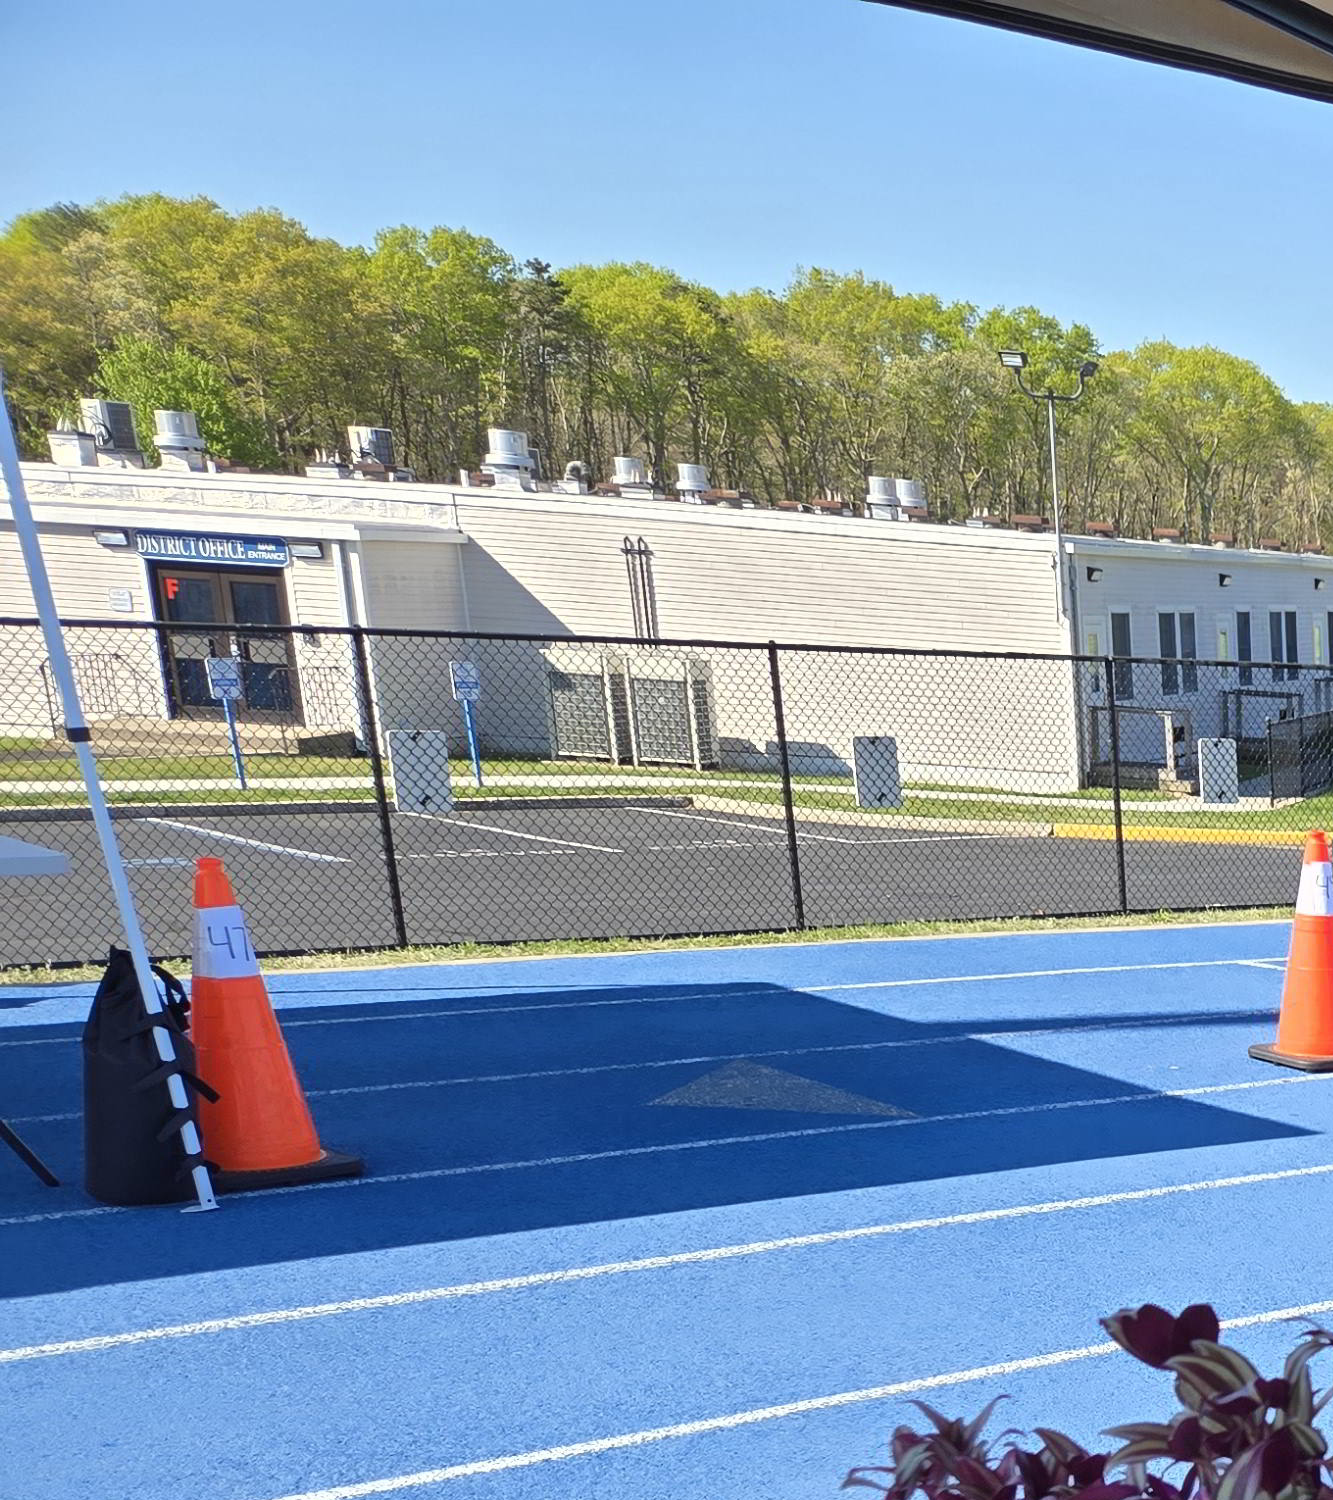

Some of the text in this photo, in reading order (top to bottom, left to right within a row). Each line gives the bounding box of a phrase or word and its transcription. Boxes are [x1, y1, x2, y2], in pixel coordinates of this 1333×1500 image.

[136, 534, 246, 559] DISTRICT OFFICE
[248, 551, 286, 561] ENTRANCE
[208, 925, 250, 962] 47
